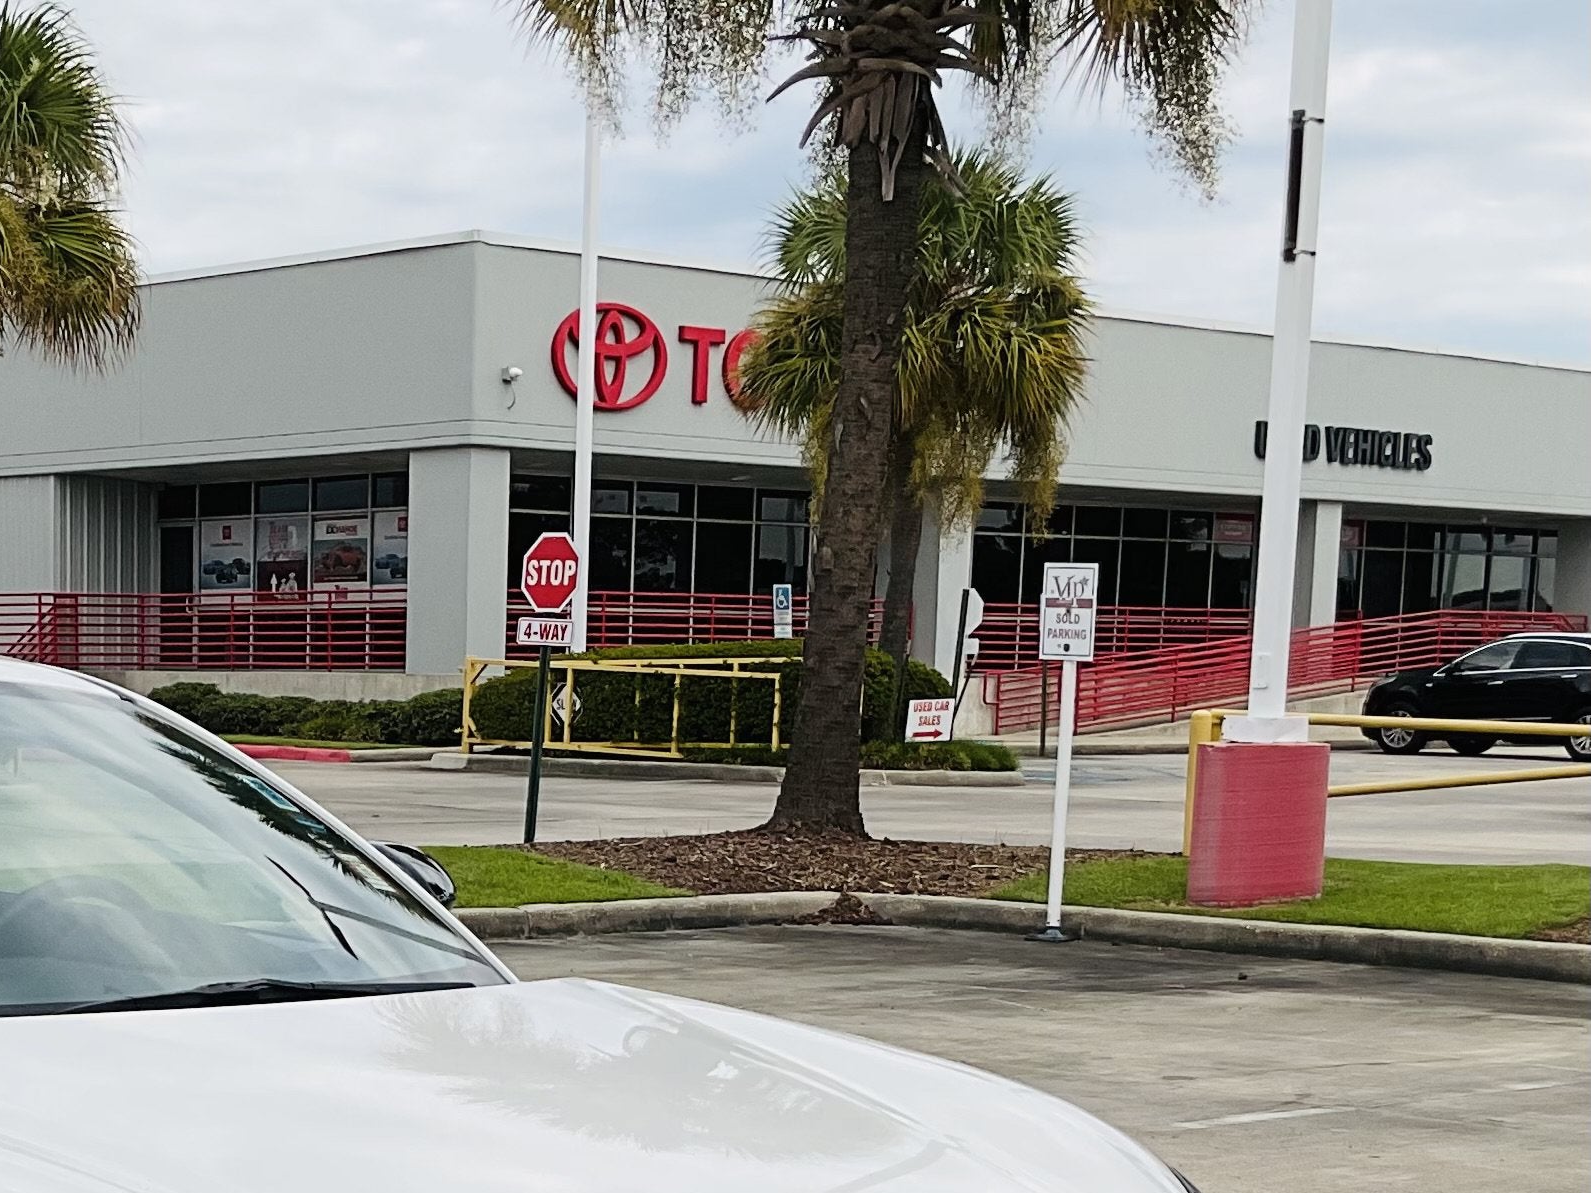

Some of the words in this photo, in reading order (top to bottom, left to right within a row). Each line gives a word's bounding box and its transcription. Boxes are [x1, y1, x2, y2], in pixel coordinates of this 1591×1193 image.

[1254, 420, 1321, 462] UD
[1324, 425, 1433, 471] VEHICLES
[526, 559, 577, 586] STOP
[1055, 613, 1081, 625] SOLD
[523, 622, 568, 642] 4-WAY
[1047, 627, 1088, 640] PARKING
[913, 702, 933, 713] USED
[935, 701, 950, 711] CAR
[918, 715, 942, 726] SALES
